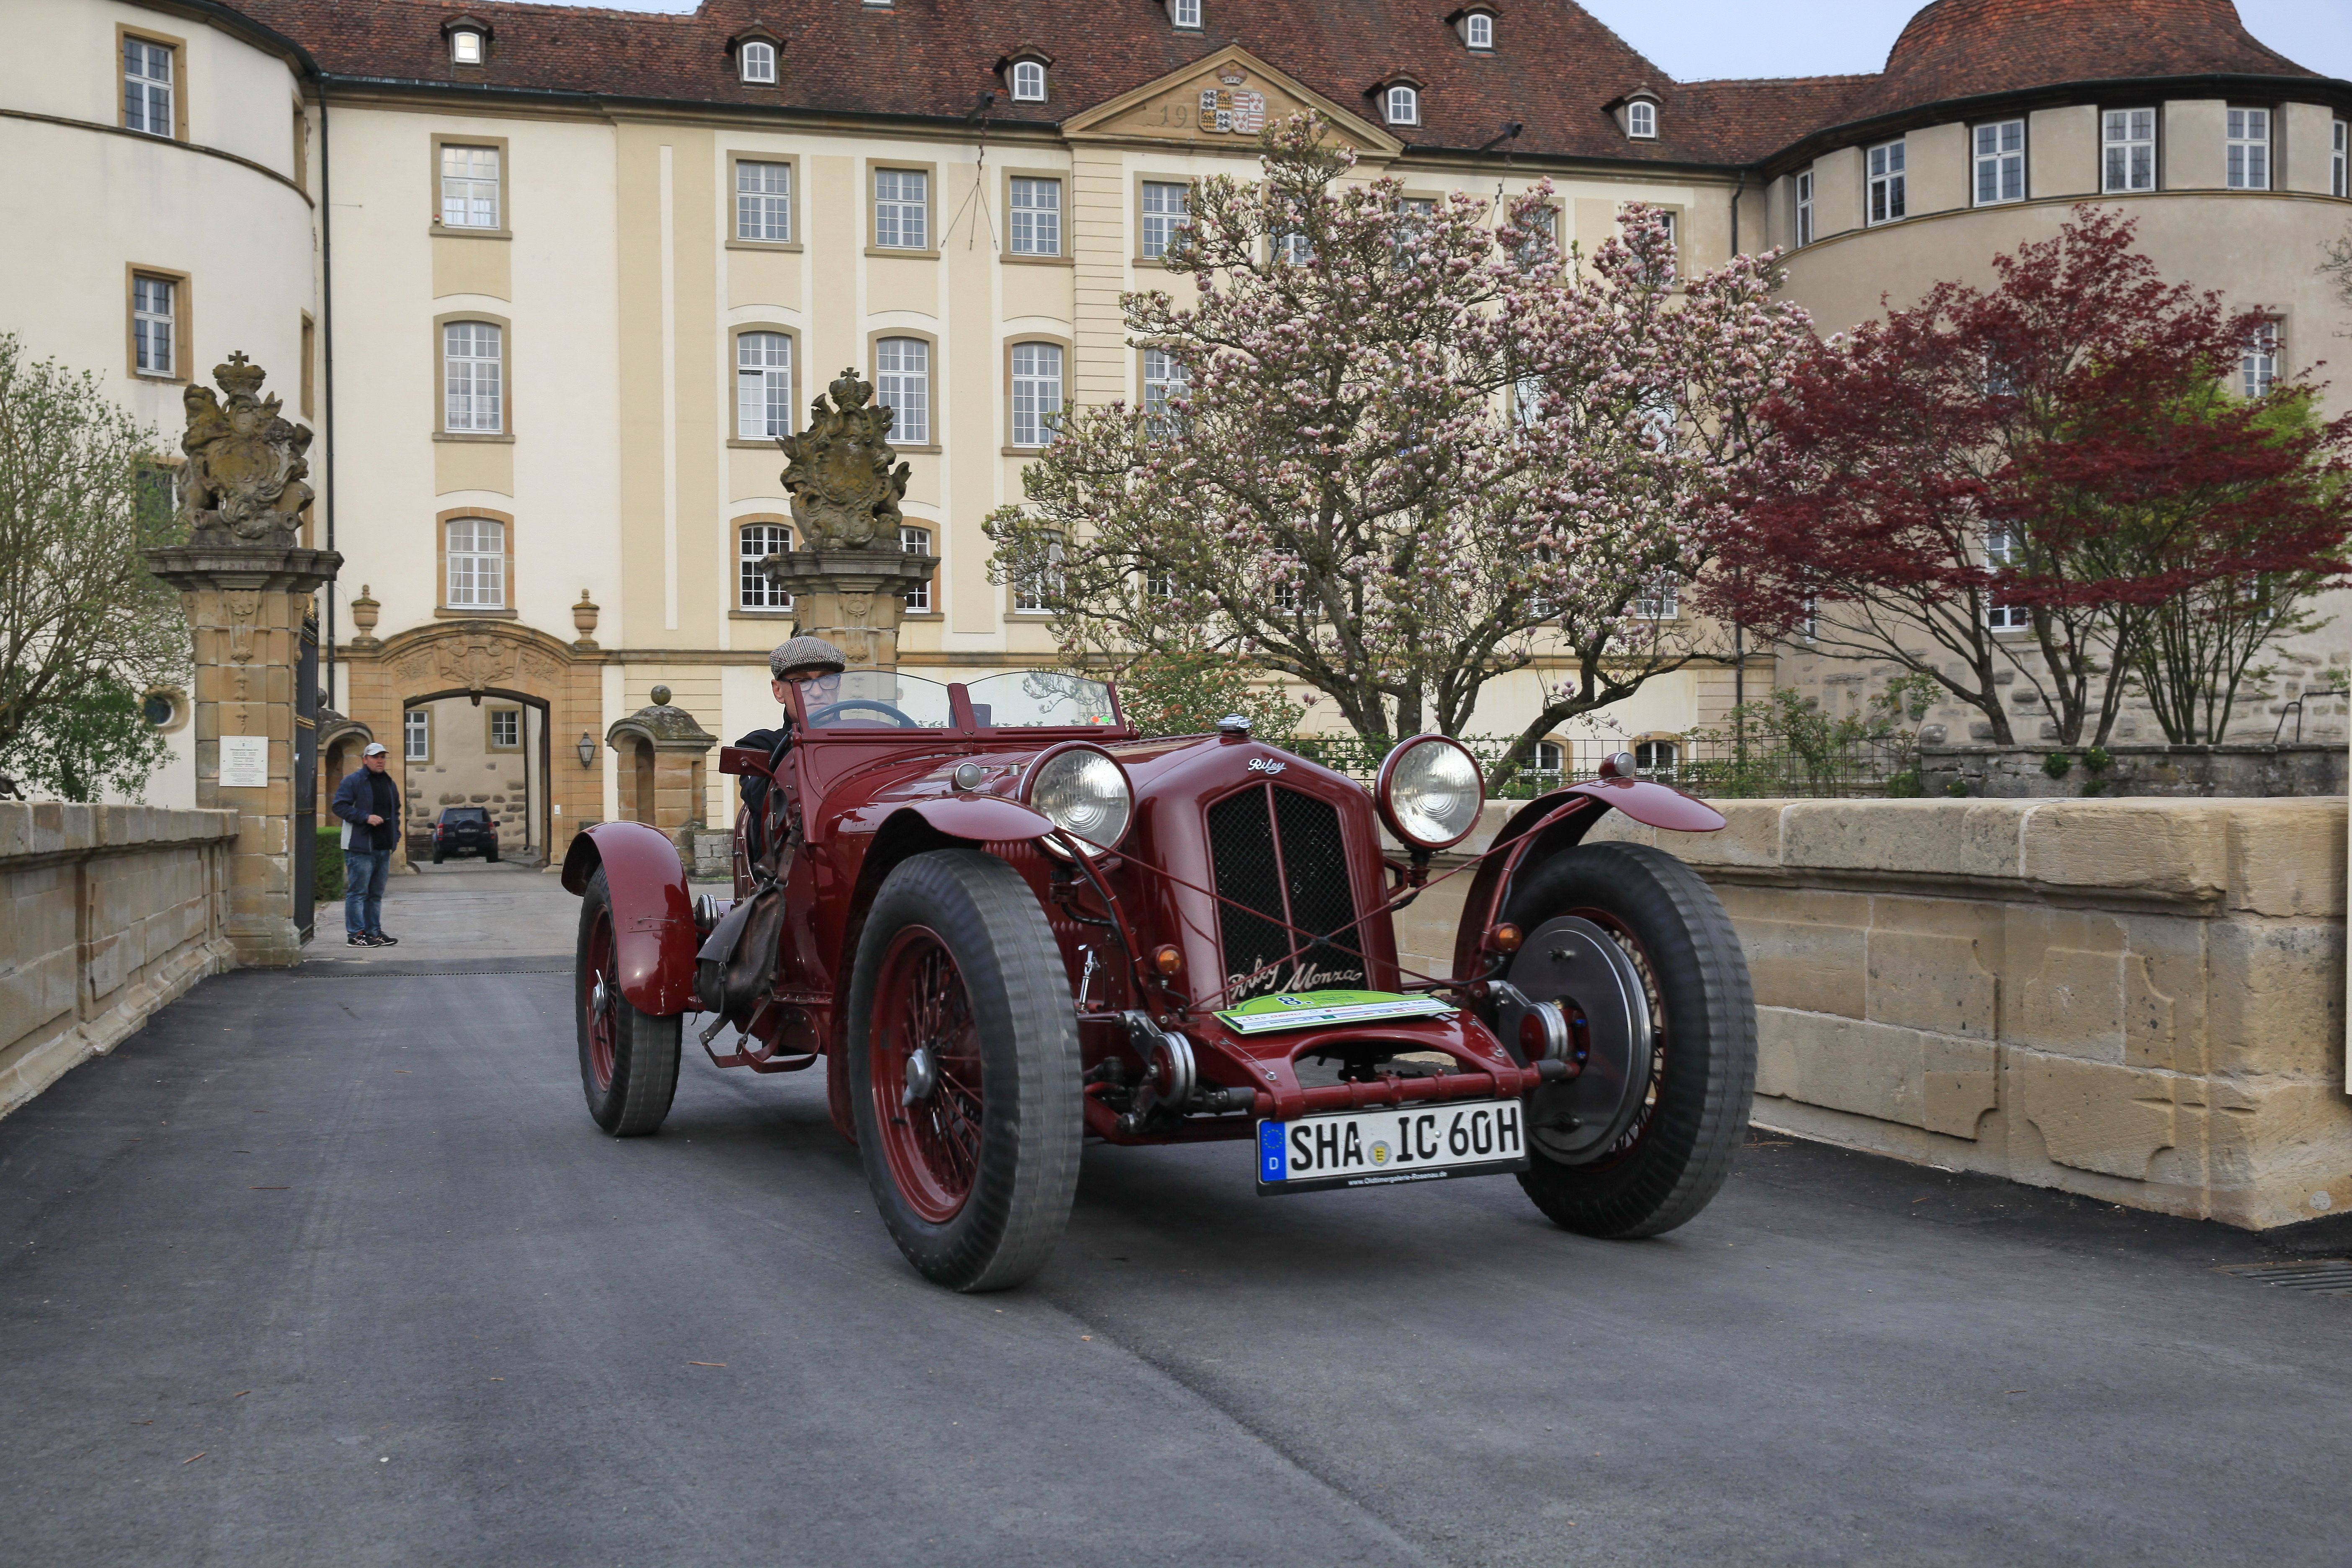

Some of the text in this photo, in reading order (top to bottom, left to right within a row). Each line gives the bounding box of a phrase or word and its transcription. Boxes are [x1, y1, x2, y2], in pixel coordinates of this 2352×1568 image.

[1160, 105, 1187, 127] 19
[1248, 758, 1287, 774] Riley
[1275, 963, 1362, 994] Monza
[1291, 1122, 1363, 1171] SHA
[1269, 1157, 1279, 1170] D
